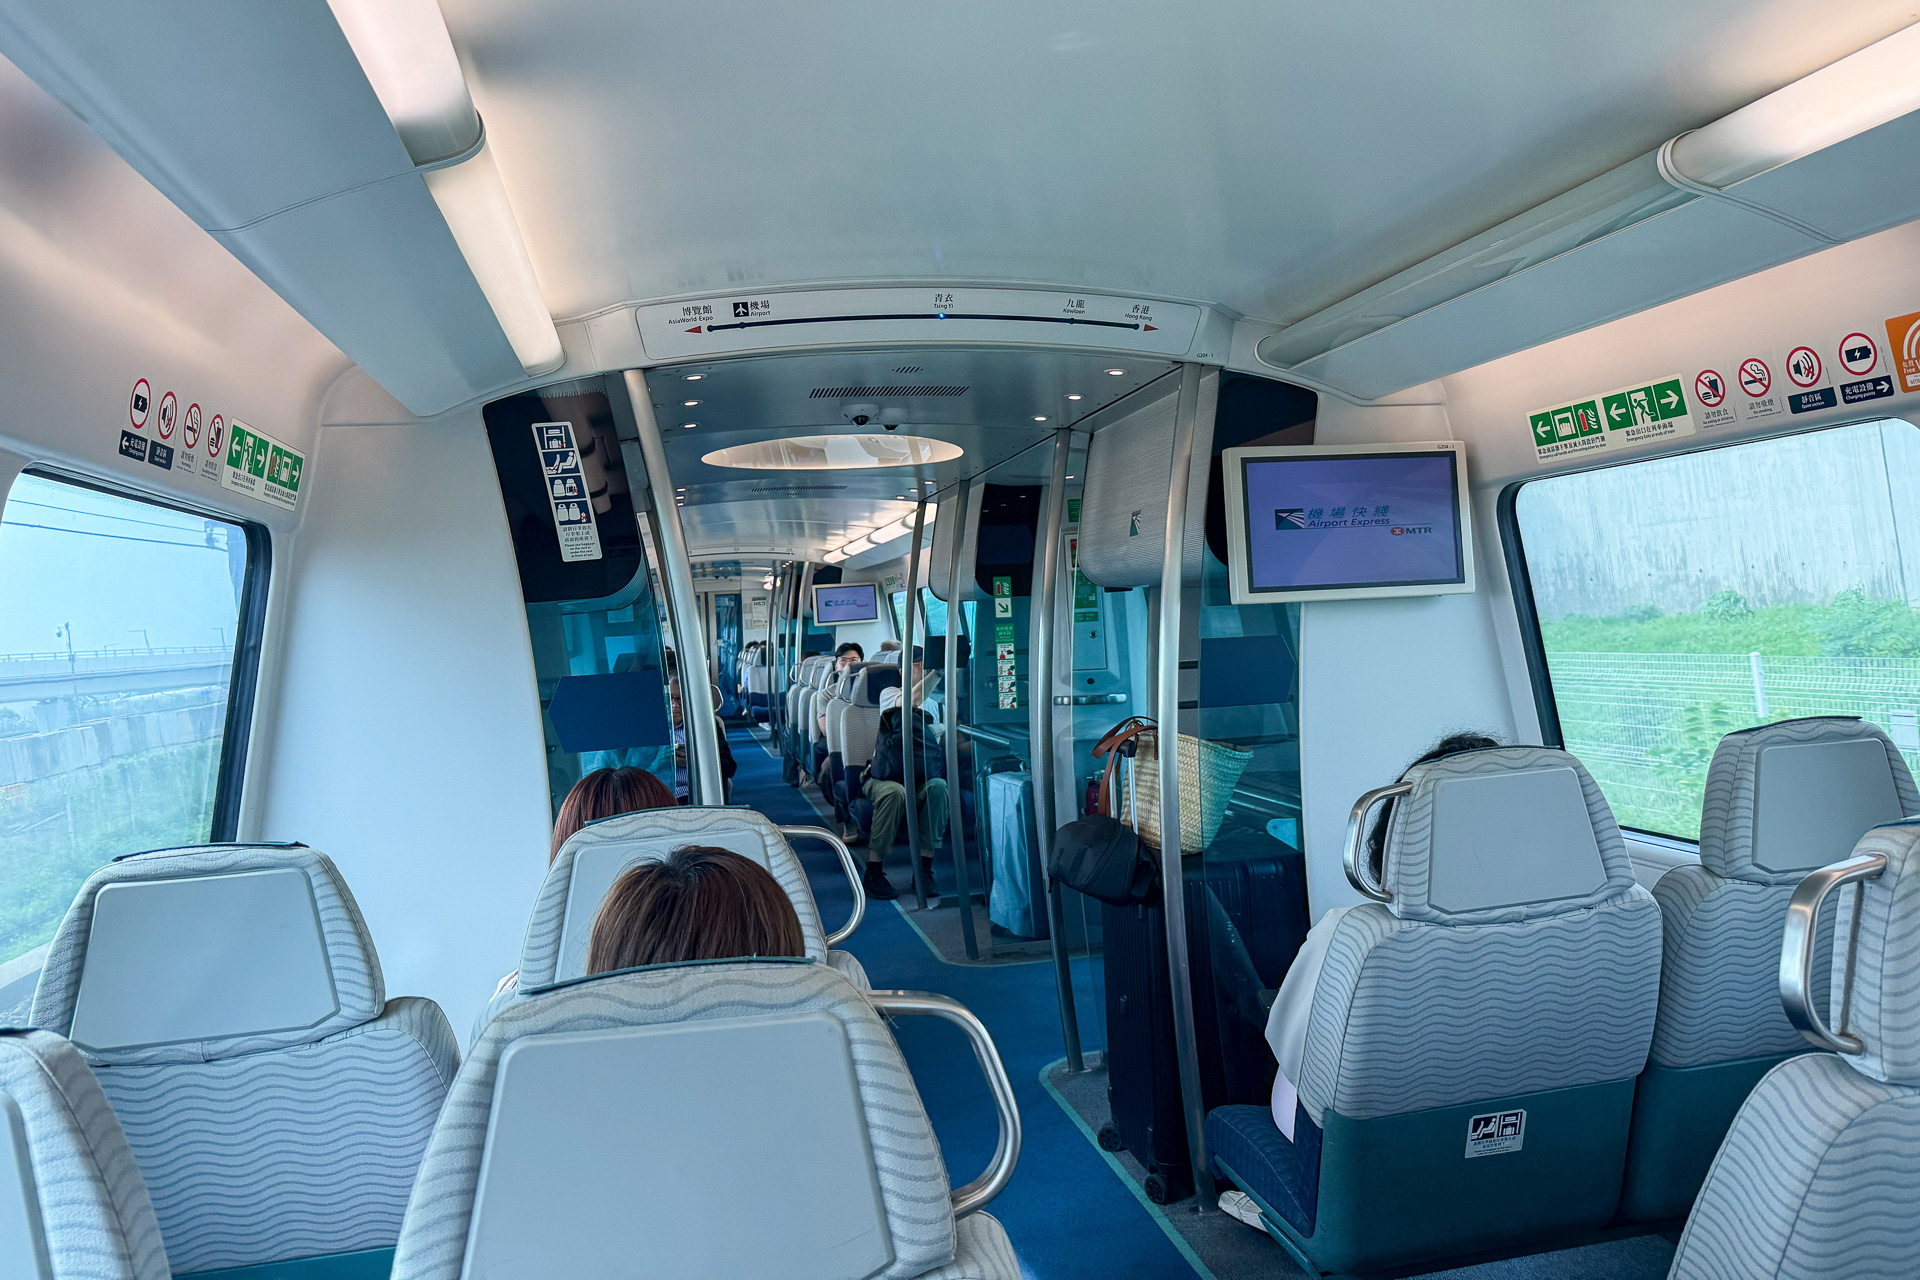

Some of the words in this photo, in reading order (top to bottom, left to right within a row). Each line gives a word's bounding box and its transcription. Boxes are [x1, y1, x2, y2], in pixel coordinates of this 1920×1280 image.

[934, 293, 954, 303] 青衣
[1066, 298, 1085, 309] 九龍
[682, 304, 712, 316] 博覽館
[749, 300, 770, 311] 機場
[1131, 304, 1150, 315] 香港
[750, 310, 771, 318] Airport
[1139, 314, 1153, 322] Kong
[668, 316, 697, 325] AsiaWorld
[1844, 382, 1874, 395] 充電設備
[1704, 408, 1729, 419] 請勿飲食
[1307, 505, 1390, 519] 機場快綫
[1307, 519, 1348, 529] Airport
[1351, 518, 1390, 527] Express
